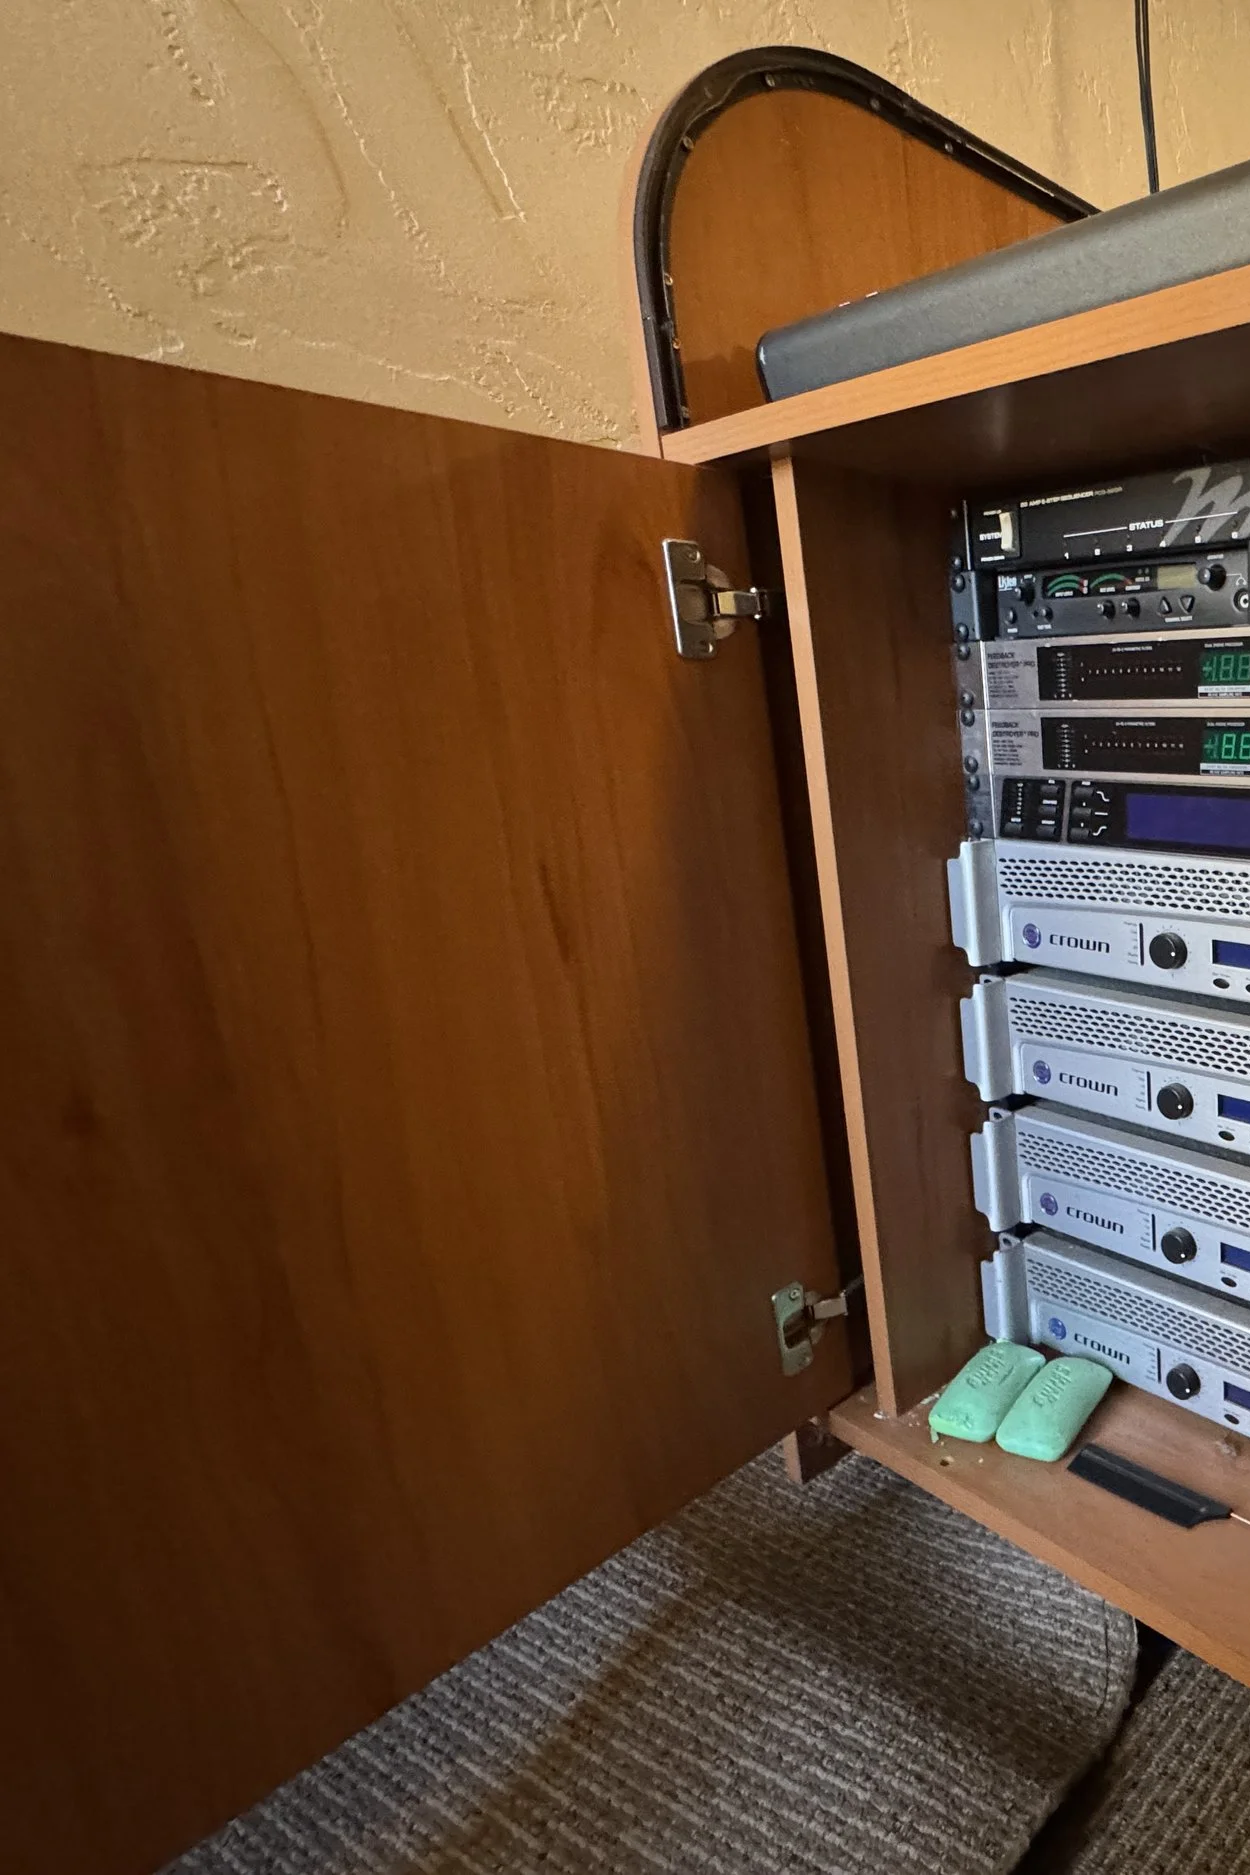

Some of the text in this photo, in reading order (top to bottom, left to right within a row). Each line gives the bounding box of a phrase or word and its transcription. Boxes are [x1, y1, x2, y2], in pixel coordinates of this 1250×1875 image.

[1129, 519, 1164, 531] STATUS
[1049, 932, 1110, 954] crown
[1059, 1071, 1119, 1097] crown
[1066, 1205, 1124, 1235] crown
[1074, 1332, 1131, 1365] crown
